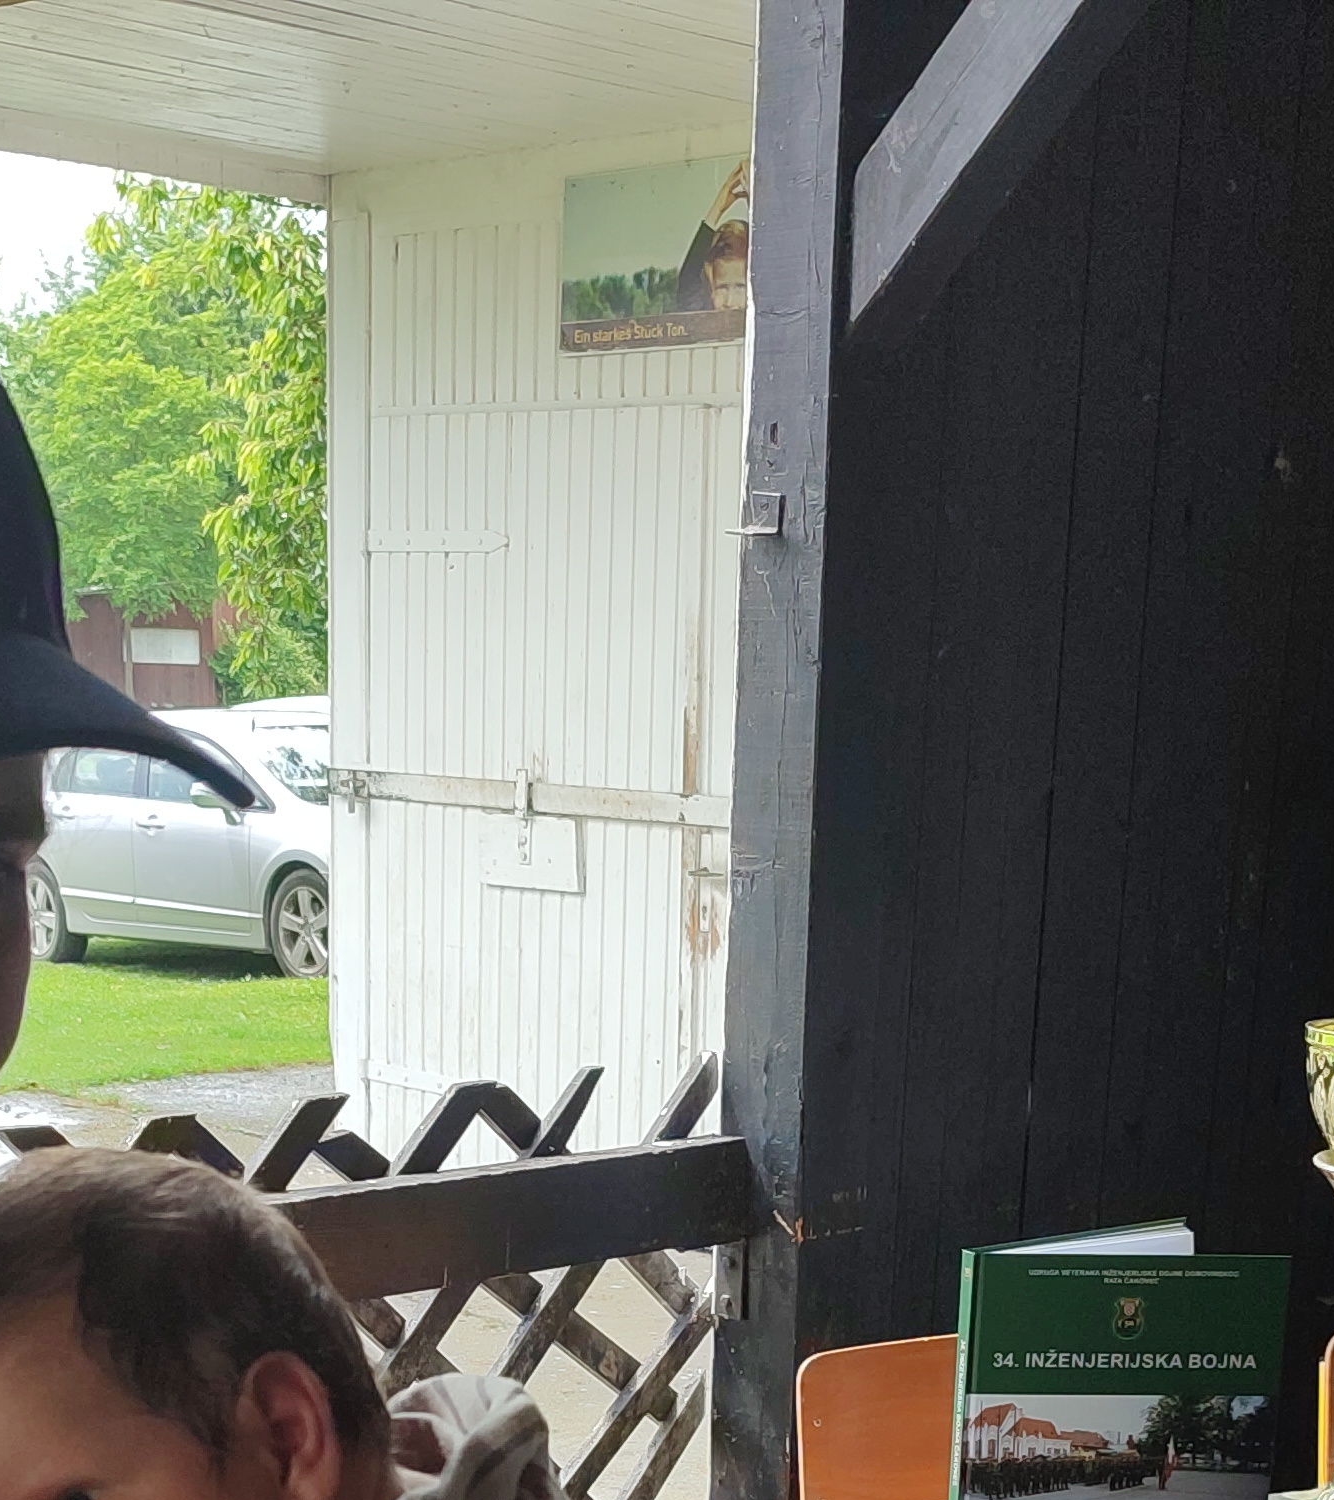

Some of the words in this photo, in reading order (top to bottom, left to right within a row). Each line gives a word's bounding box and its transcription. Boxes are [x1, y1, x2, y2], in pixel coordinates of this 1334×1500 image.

[574, 329, 591, 344] Ein
[592, 325, 632, 343] starkes
[992, 1352, 1020, 1369] 34.
[1025, 1348, 1183, 1369] INŽENJERIJSKA
[1188, 1353, 1257, 1369] BOJNA
